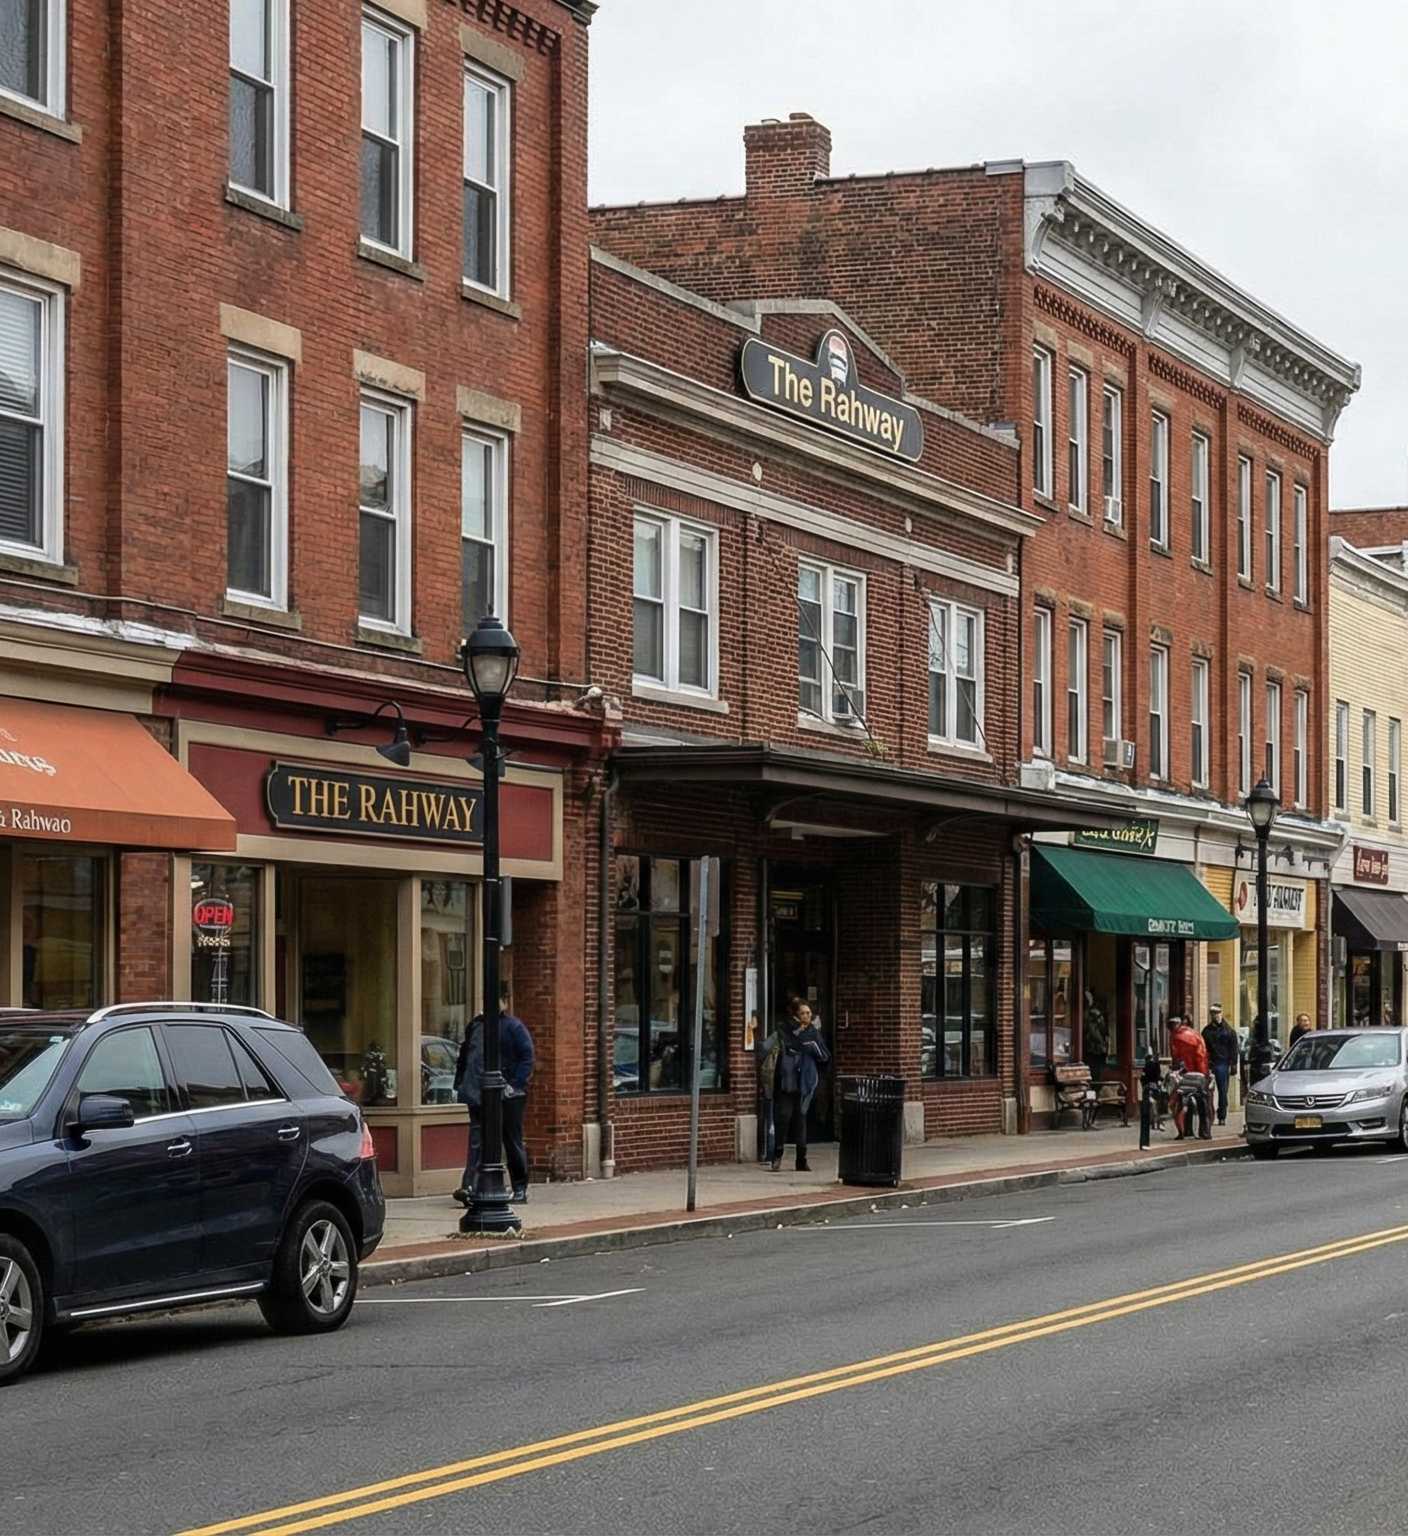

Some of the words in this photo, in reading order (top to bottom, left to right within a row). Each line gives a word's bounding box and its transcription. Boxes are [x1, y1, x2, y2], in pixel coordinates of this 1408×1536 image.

[768, 354, 813, 408] The
[820, 376, 904, 452] Rahway
[287, 775, 351, 820] THE
[358, 784, 477, 832] RAHWAY
[194, 904, 233, 926] OPEN
